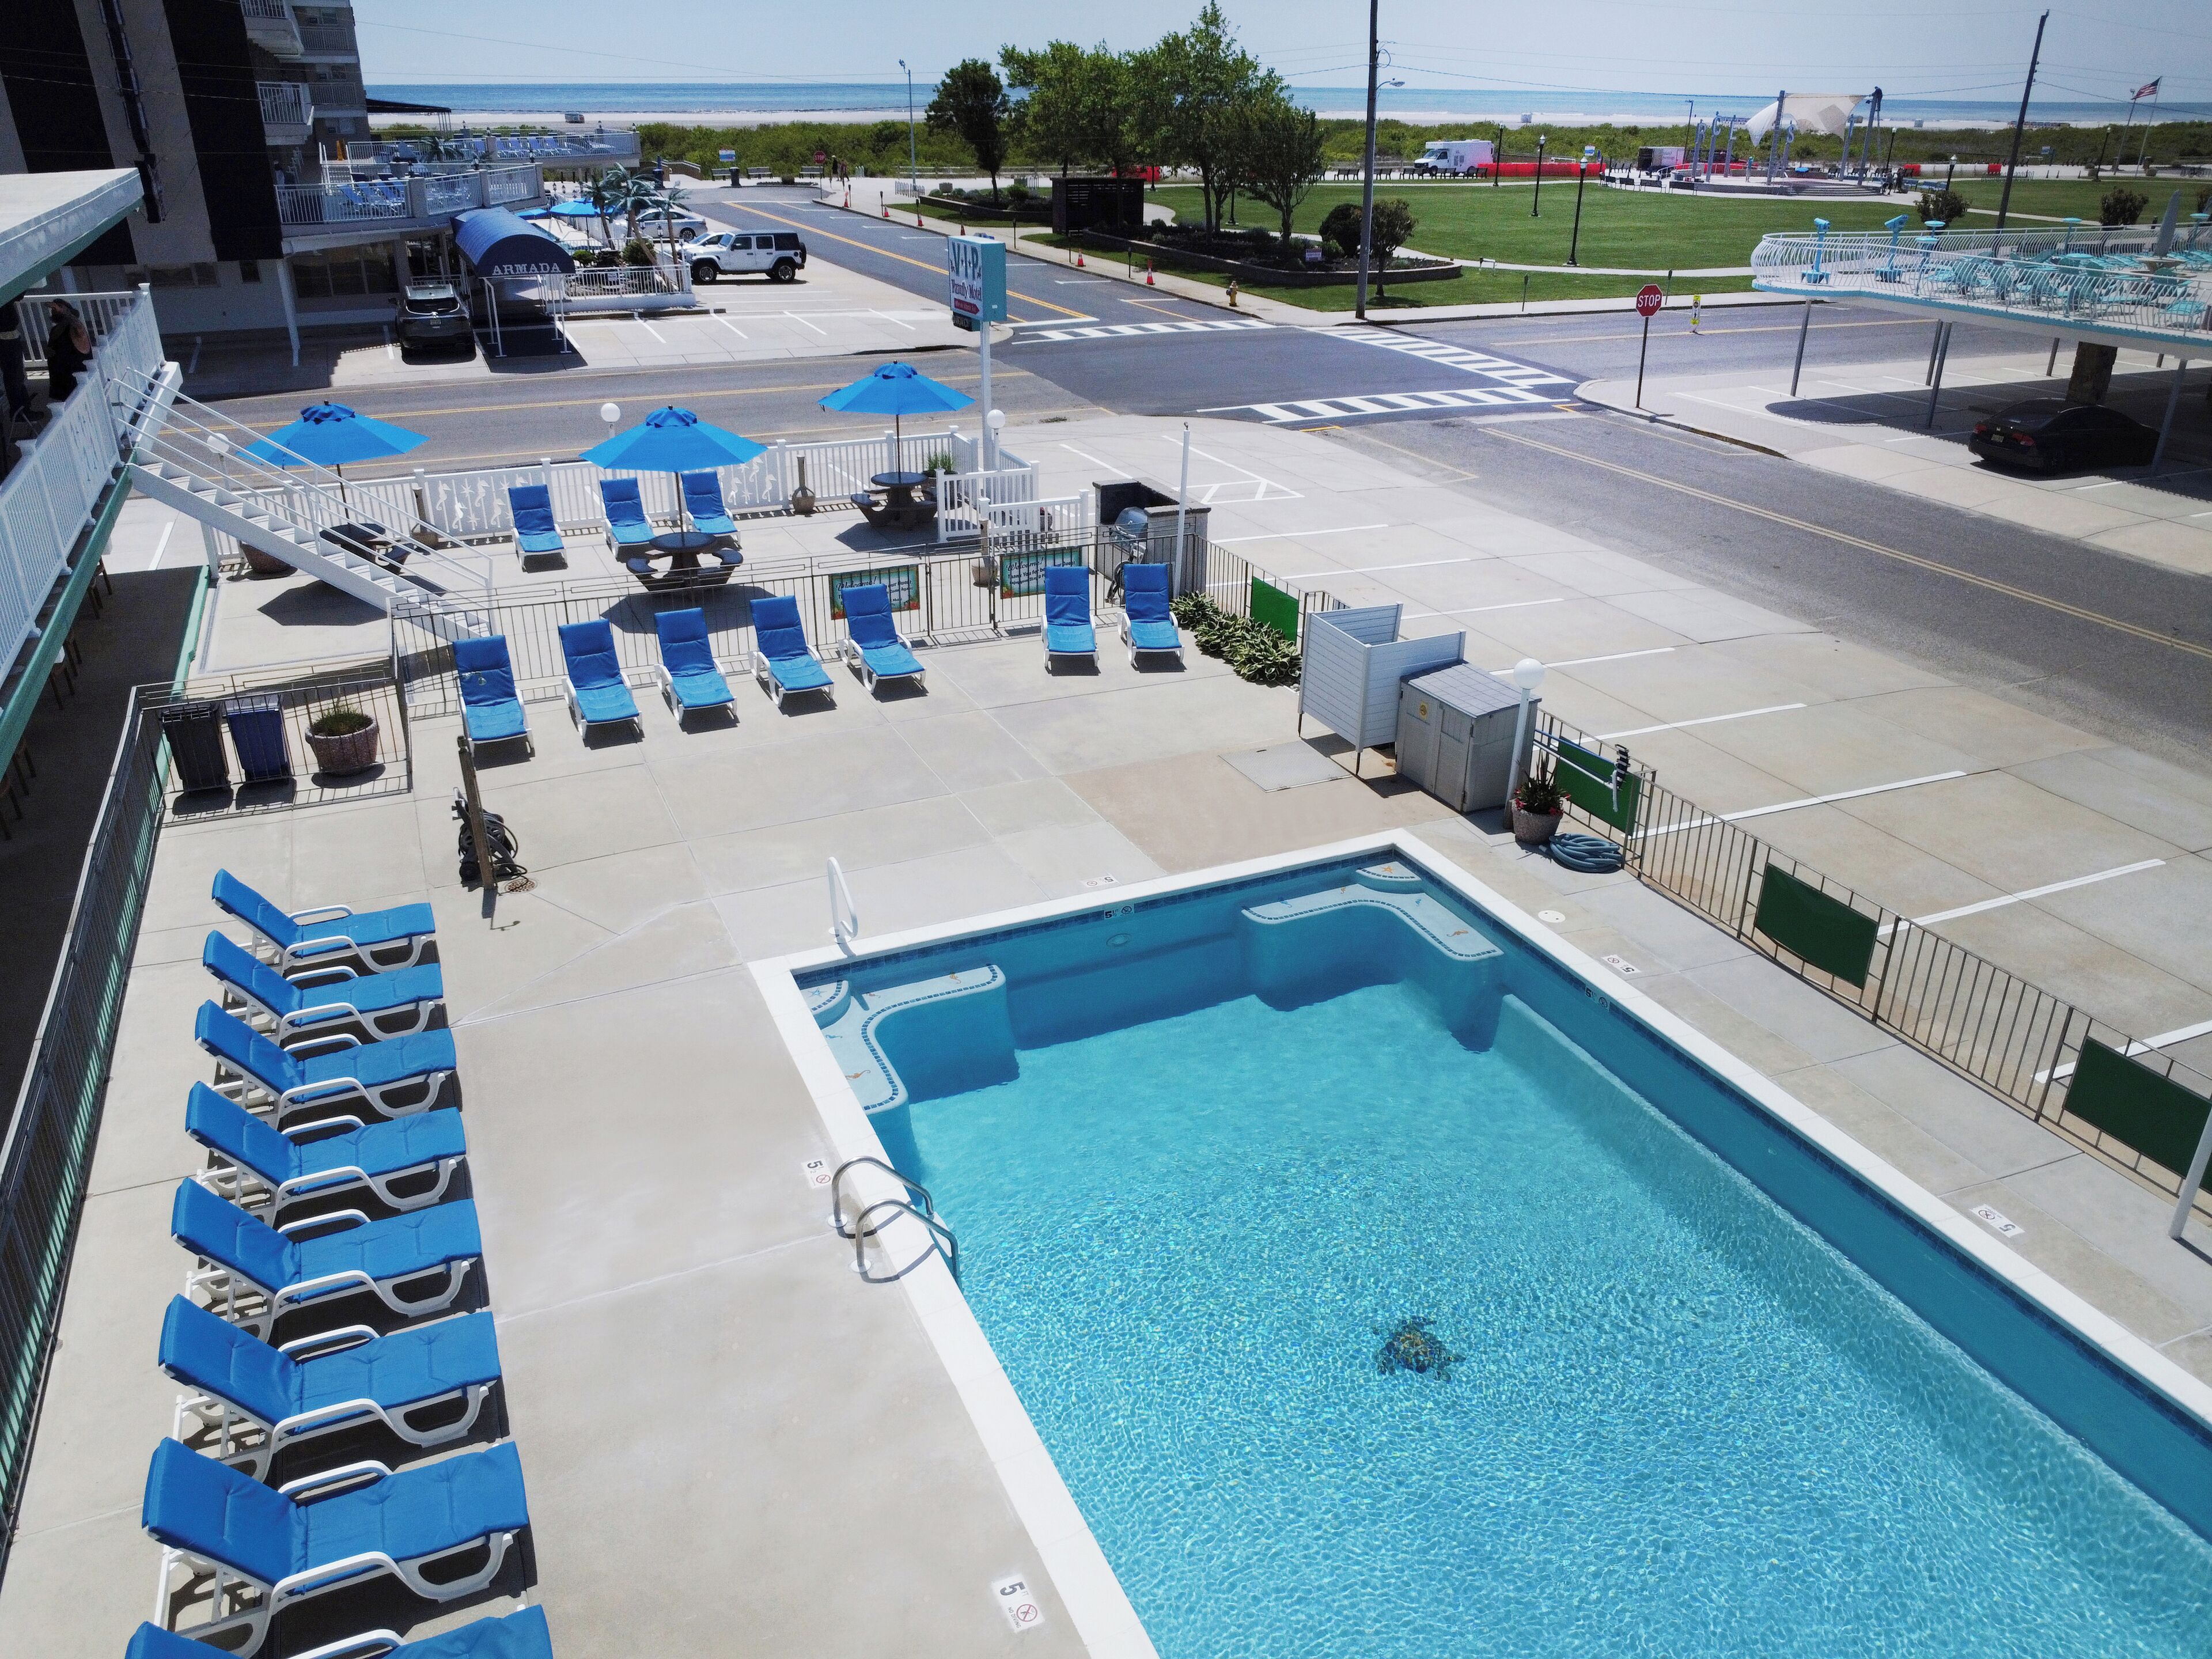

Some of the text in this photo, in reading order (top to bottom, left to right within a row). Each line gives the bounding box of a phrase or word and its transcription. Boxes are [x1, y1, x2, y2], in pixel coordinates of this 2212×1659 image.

[492, 263, 562, 275] ARMADA
[969, 285, 982, 301] Motel
[1638, 294, 1661, 308] STOP
[1006, 556, 1044, 571] Welcome!
[1999, 1224, 2016, 1232] 5
[999, 1581, 1026, 1596] 5
[1010, 1613, 1022, 1629] DIVING
